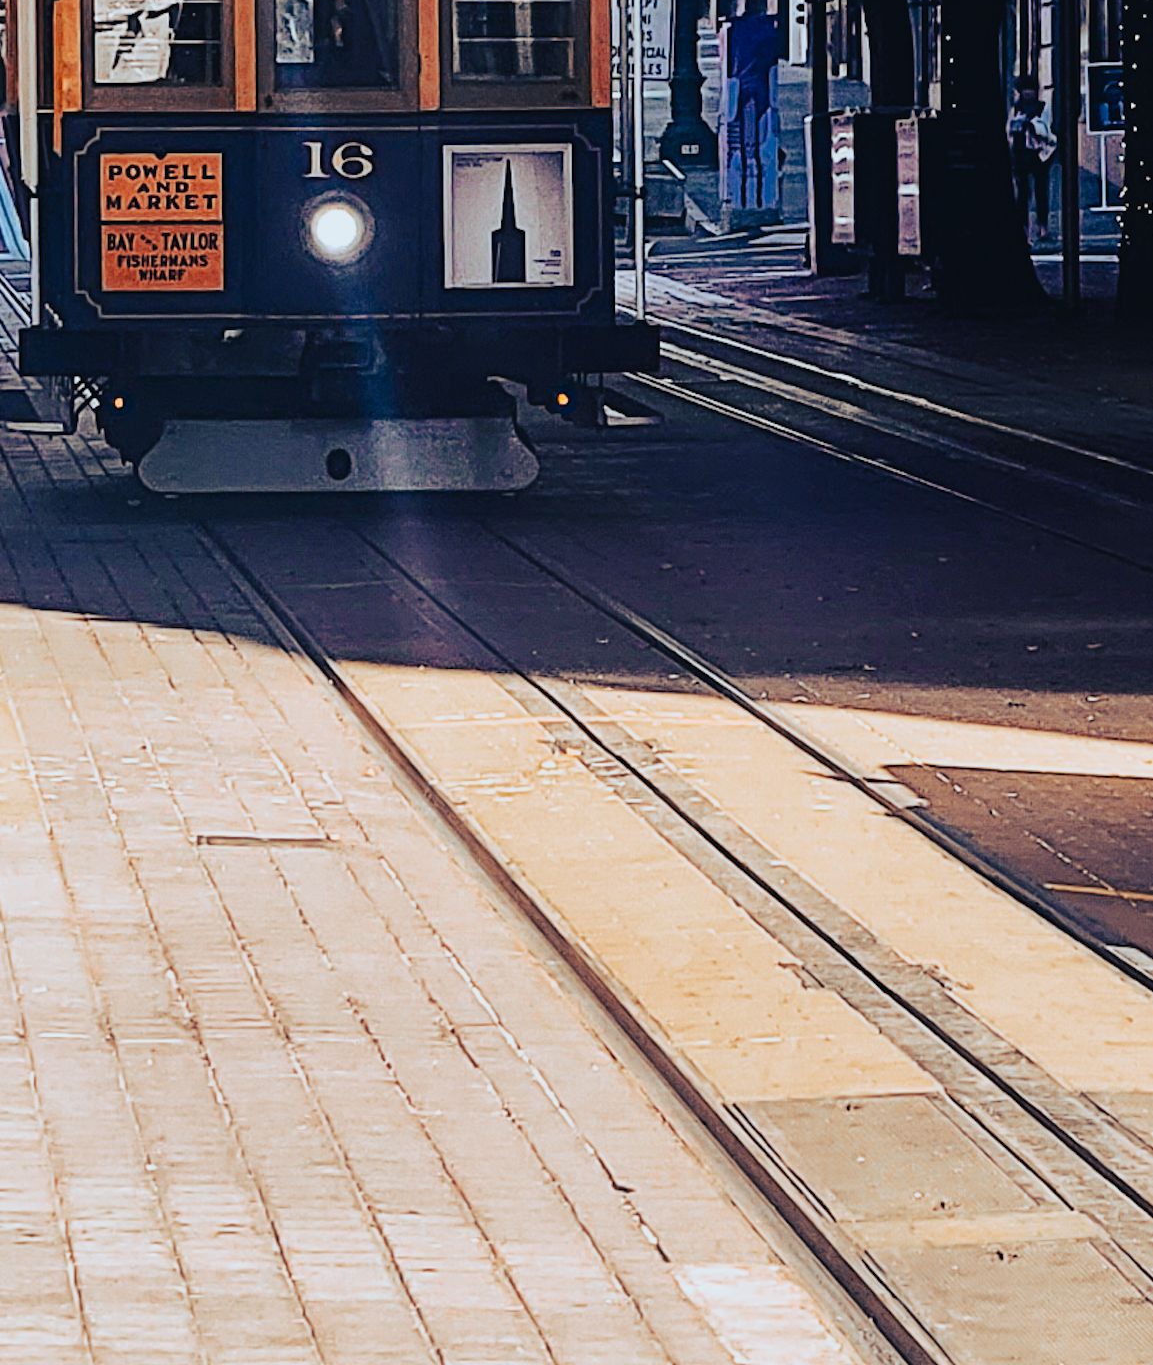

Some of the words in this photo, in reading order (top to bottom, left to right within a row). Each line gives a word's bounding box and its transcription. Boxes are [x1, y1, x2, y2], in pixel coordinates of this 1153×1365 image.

[301, 141, 374, 179] 16
[108, 164, 216, 181] POWELL
[137, 181, 190, 193] AND
[106, 194, 218, 211] MARKET
[107, 233, 135, 251] BAY
[161, 232, 218, 251] TAYLOR
[117, 255, 209, 268] FISHERMANS
[139, 269, 186, 282] WHARF
